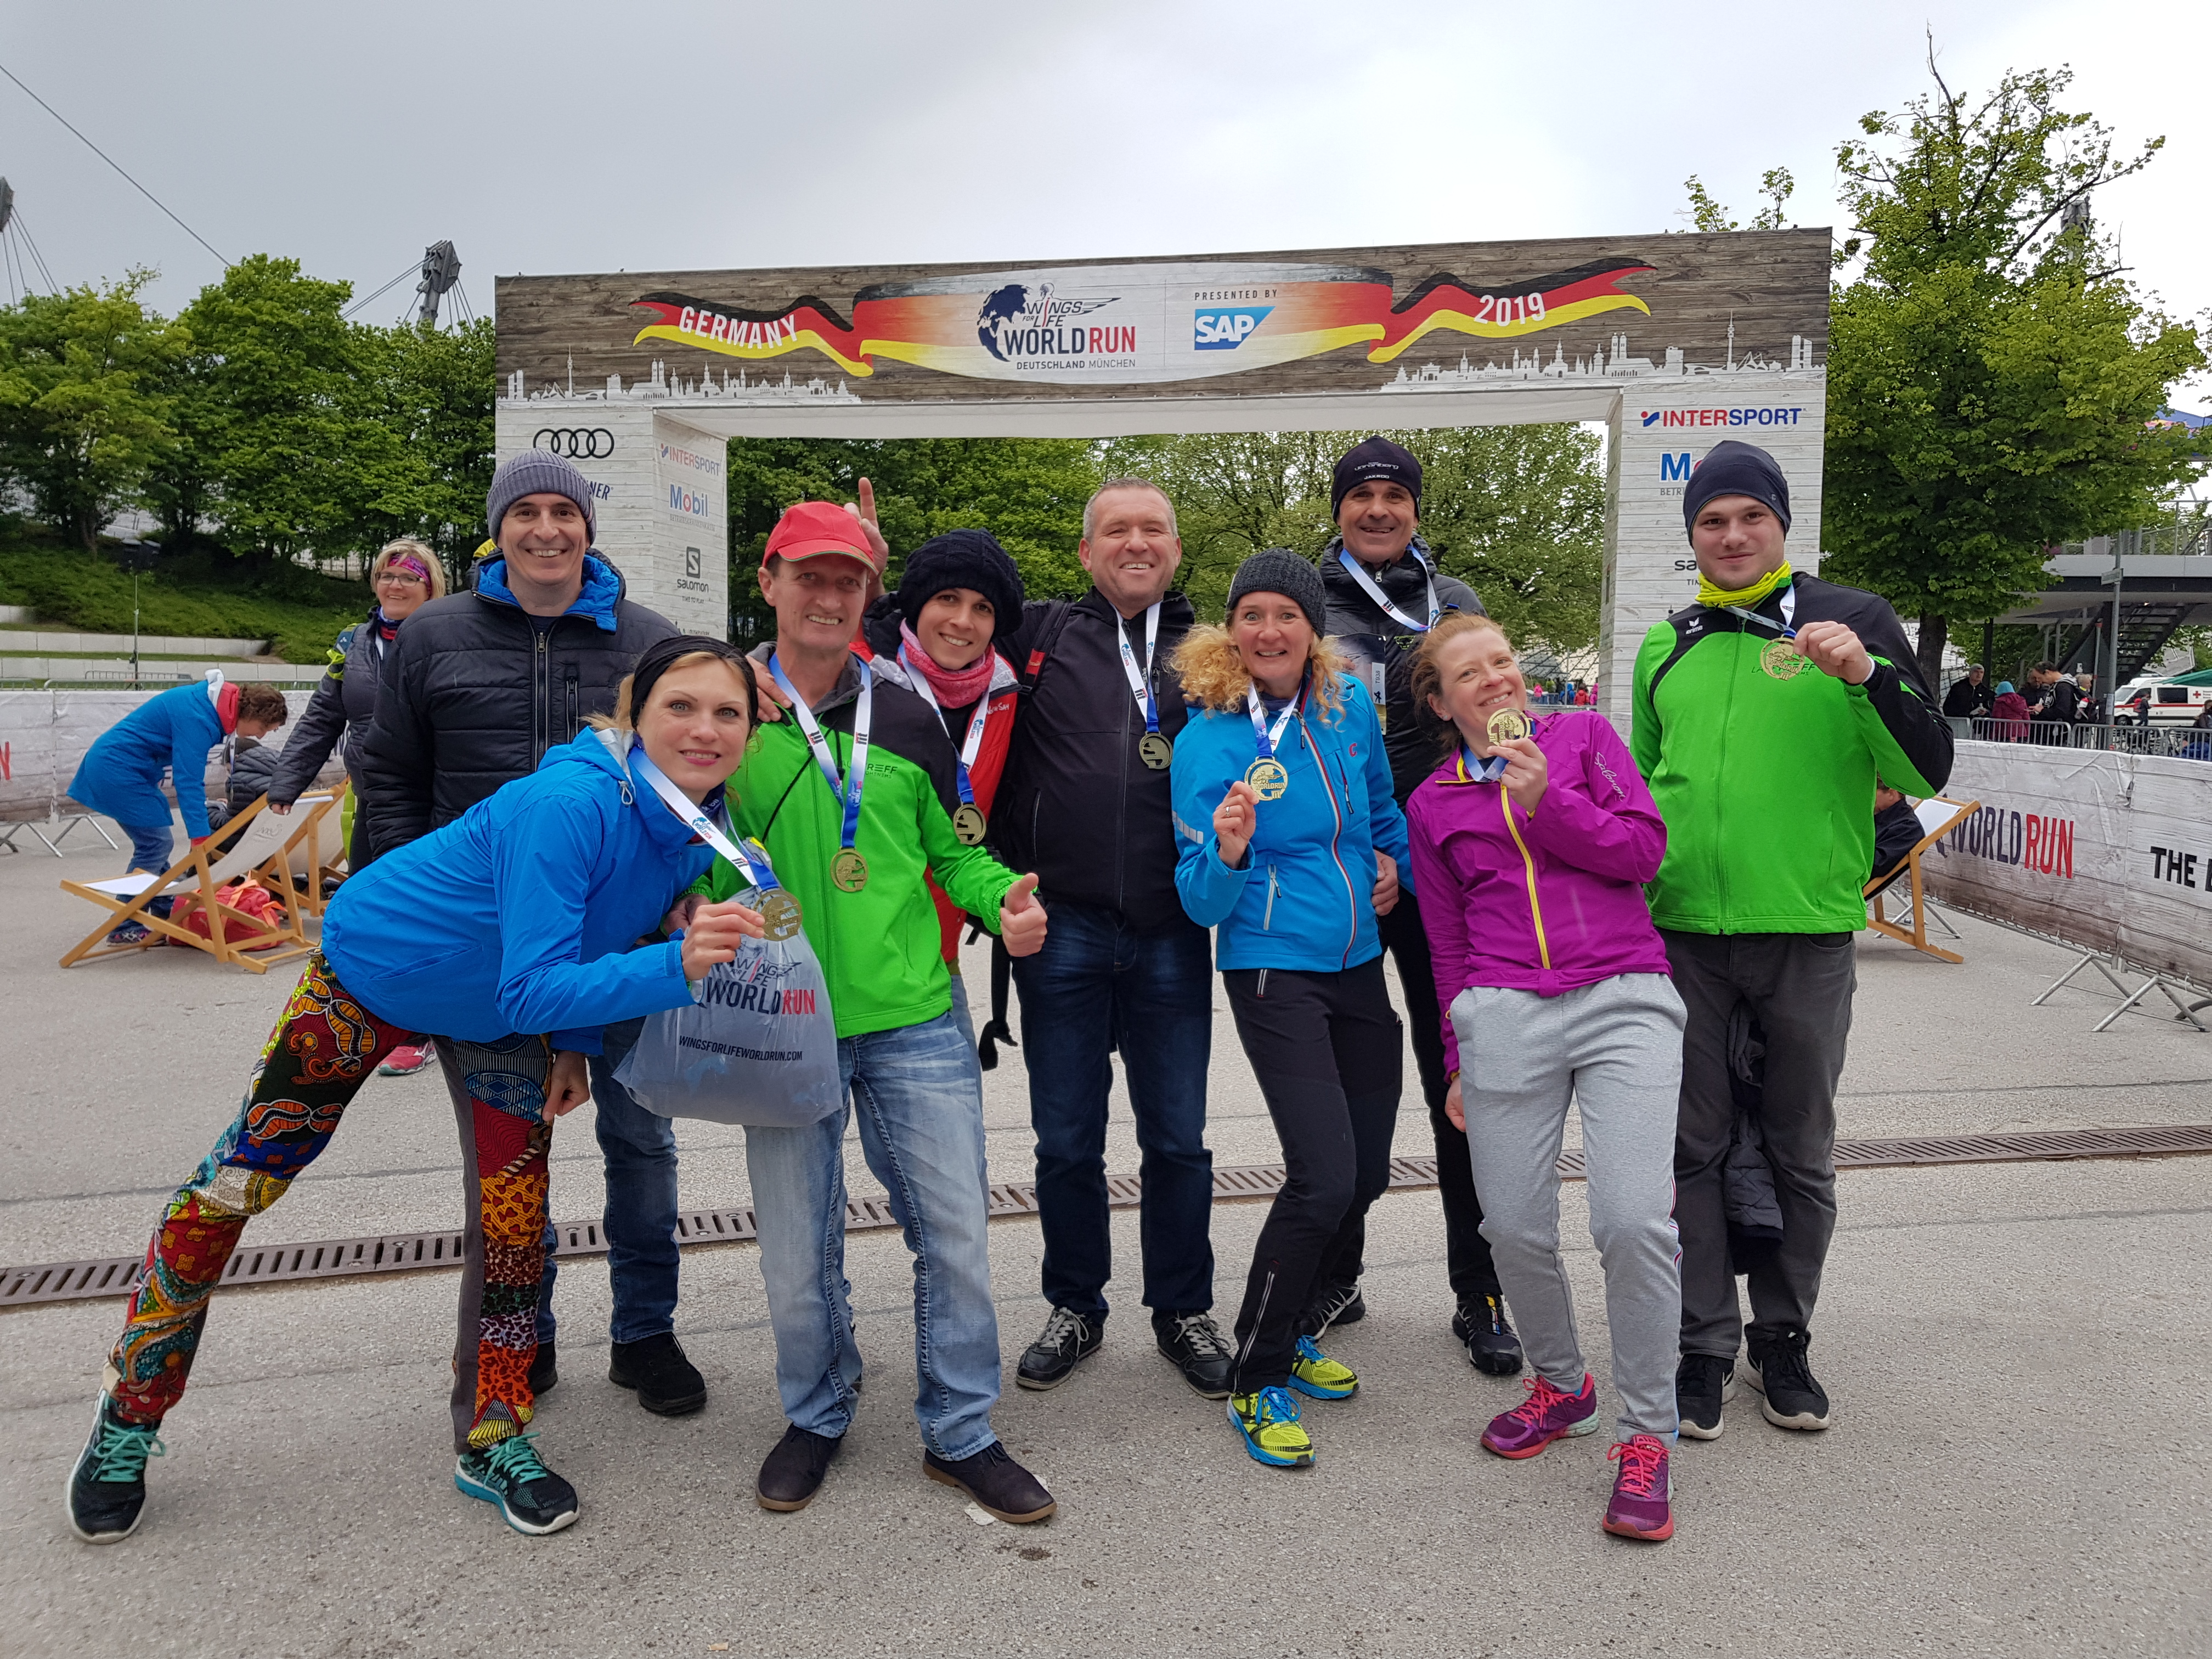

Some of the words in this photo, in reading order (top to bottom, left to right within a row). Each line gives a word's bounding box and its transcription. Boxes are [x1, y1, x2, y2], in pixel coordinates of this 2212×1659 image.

[1195, 290, 1257, 300] PRESENTED
[1265, 289, 1277, 297] BY
[1026, 298, 1083, 314] WINGS
[1475, 292, 1545, 327] 2019
[679, 306, 797, 349] GERMANY
[1033, 314, 1066, 328] LIFE
[1195, 314, 1255, 343] SAP
[1017, 360, 1085, 370] DEUTSCHLAND
[1089, 358, 1136, 369] MÜNCHEN
[1663, 408, 1802, 427] INTERSPORT
[669, 446, 720, 476] INTERSPORT
[670, 484, 708, 517] Mobil
[677, 579, 709, 593] salomon
[1686, 625, 1703, 634] erima
[2150, 846, 2197, 888] THE
[738, 969, 772, 987] LIFE
[679, 1035, 803, 1061] WINGSFORLIFEWORLDRUN.COM
